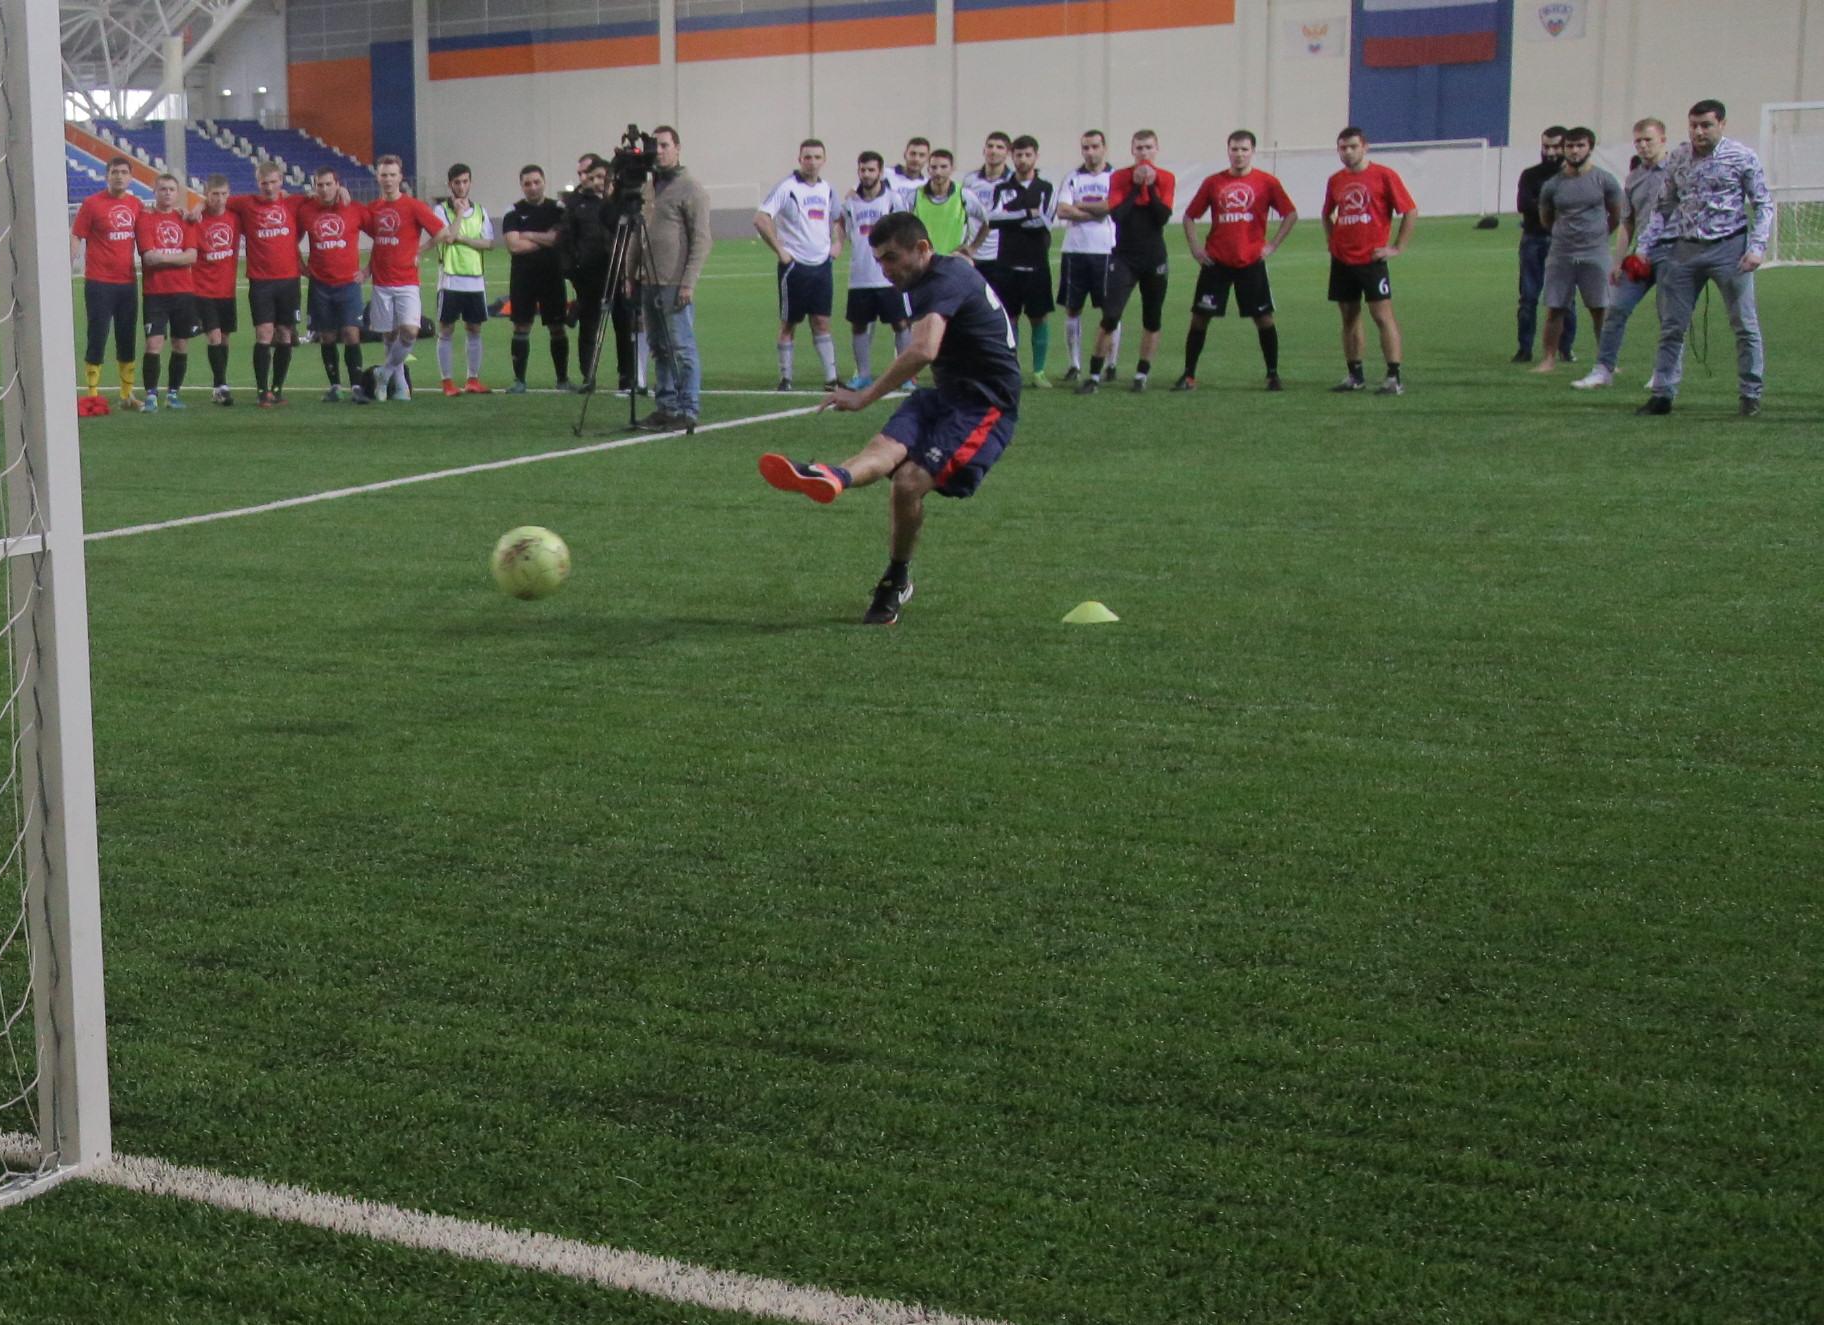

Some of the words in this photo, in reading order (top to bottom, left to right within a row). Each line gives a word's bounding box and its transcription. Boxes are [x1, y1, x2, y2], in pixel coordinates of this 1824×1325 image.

[1219, 211, 1255, 223] КПРФ
[1338, 213, 1372, 225] КПРФ
[257, 227, 290, 239] КПРФ
[315, 239, 347, 249] КПРФ
[206, 248, 234, 261] КПРФ
[1379, 278, 1389, 295] 6
